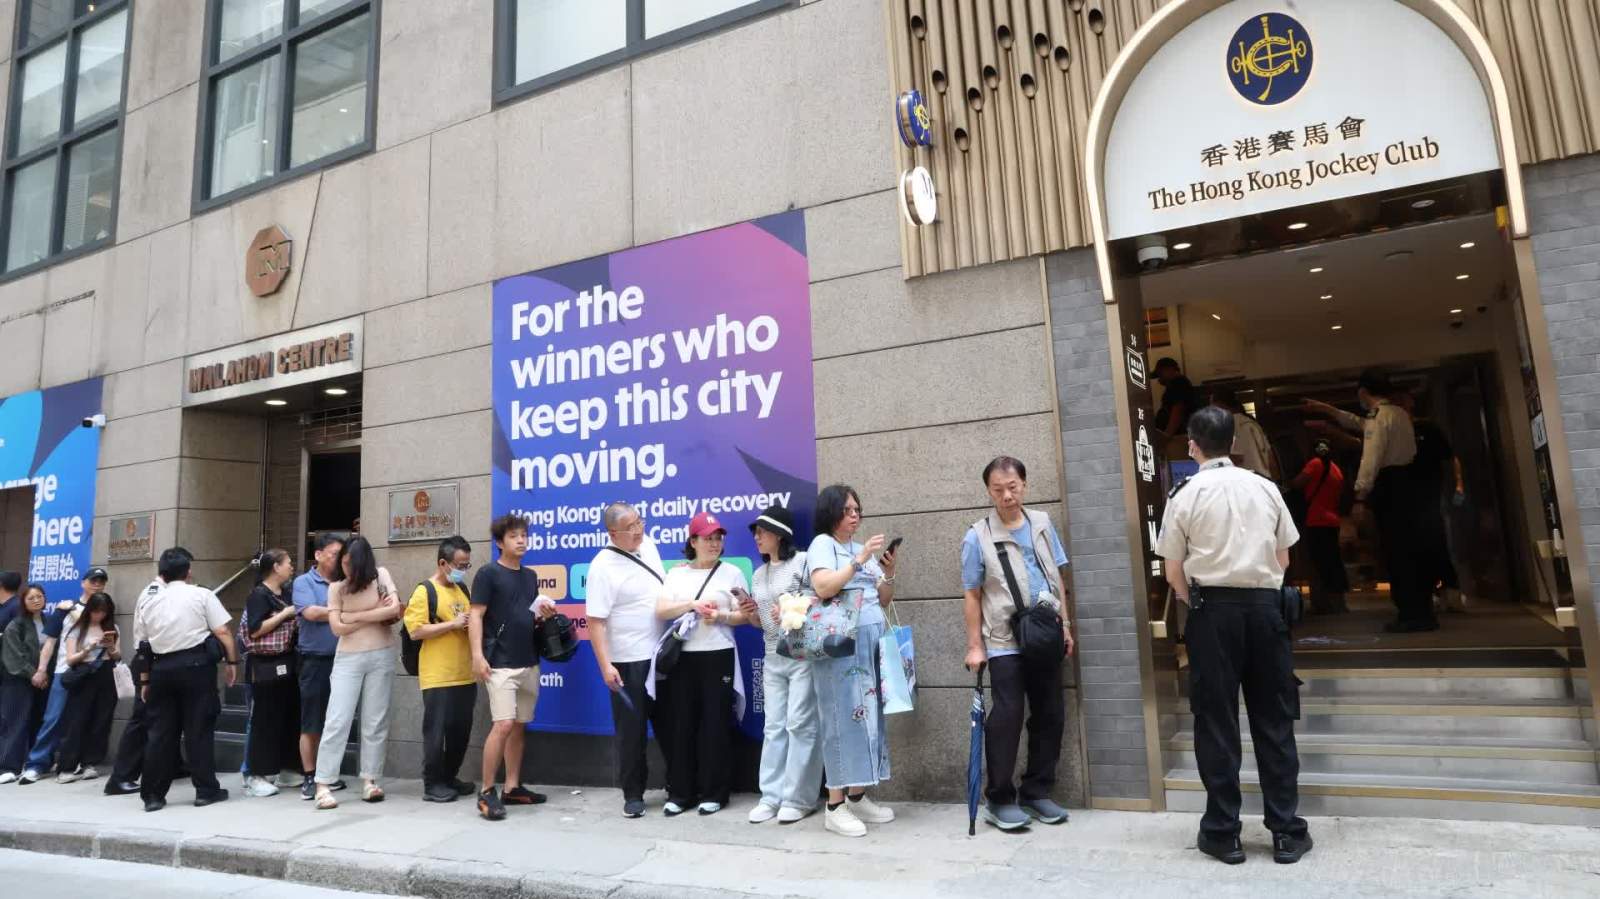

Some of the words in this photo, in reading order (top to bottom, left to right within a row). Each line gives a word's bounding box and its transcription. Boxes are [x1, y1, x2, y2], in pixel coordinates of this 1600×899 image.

[1200, 115, 1365, 168] 香港賽馬會
[1148, 187, 1186, 210] The
[1190, 178, 1245, 202] Hong
[1247, 168, 1302, 192] Kong
[1305, 152, 1380, 186] Jockey
[1384, 135, 1440, 166] Club
[511, 299, 571, 341] For
[575, 284, 645, 329] the
[276, 332, 354, 375] CENTRE
[510, 332, 666, 390] winners
[672, 313, 780, 364] who
[510, 396, 608, 441] keep
[614, 377, 690, 427] this
[697, 368, 783, 419] city
[511, 439, 678, 491] moving.
[650, 496, 699, 518] daily
[701, 491, 791, 513] recovery
[527, 532, 545, 551] ub
[546, 531, 558, 550] is
[560, 528, 610, 550] comin
